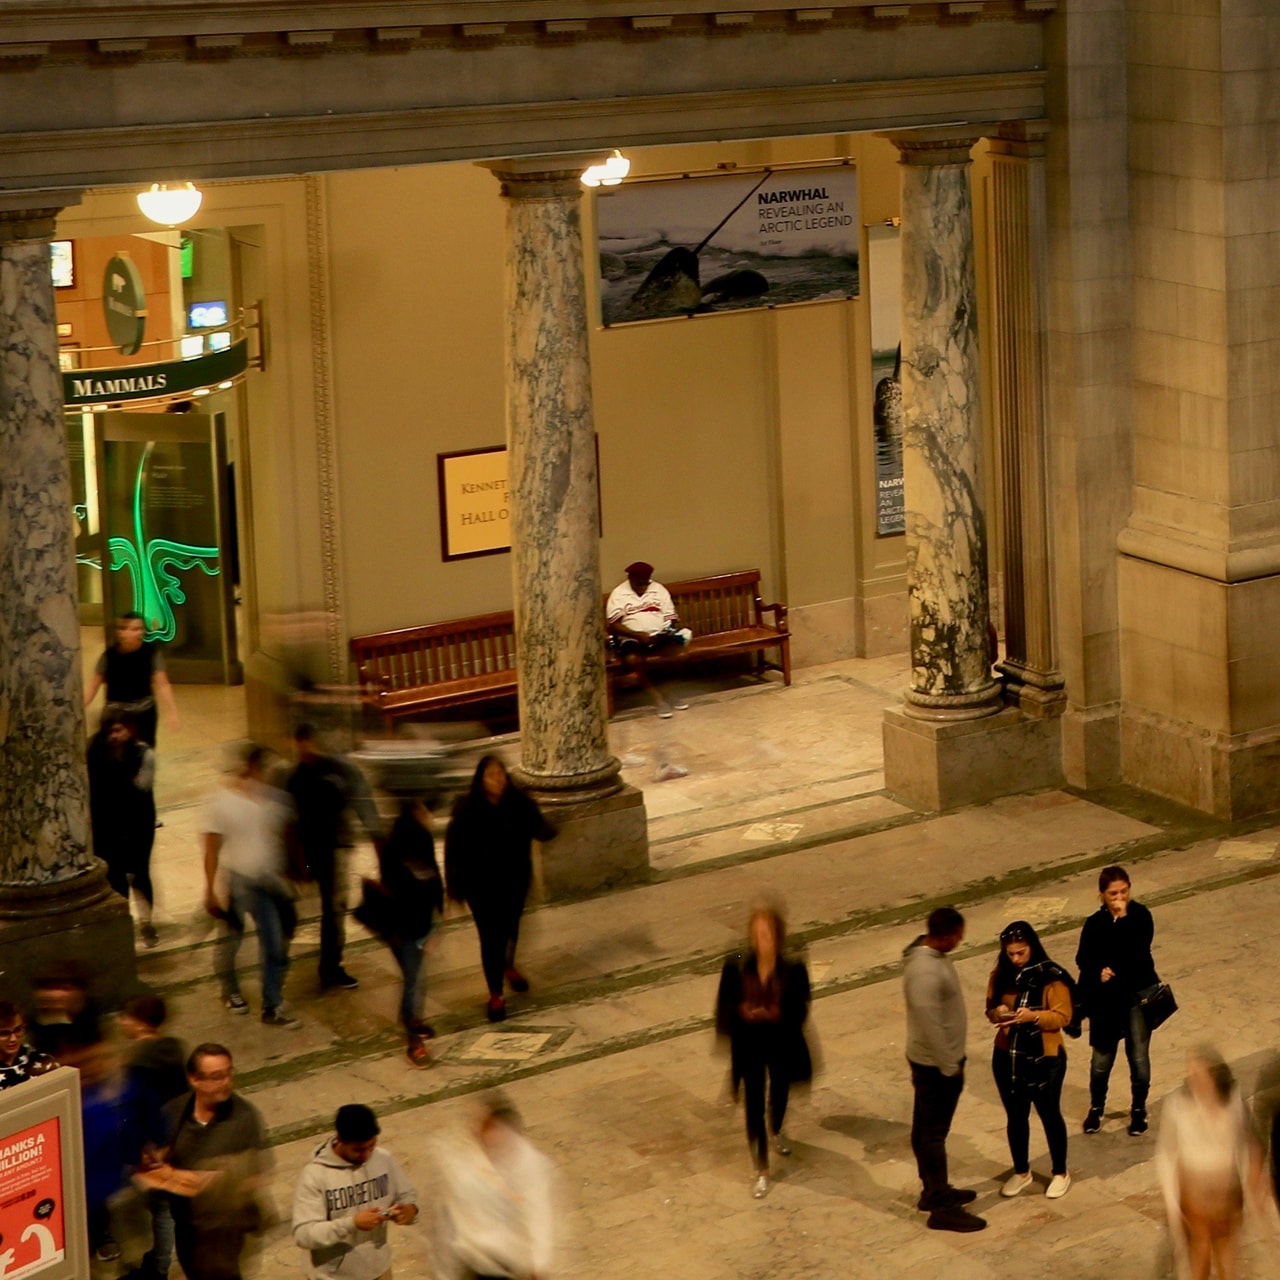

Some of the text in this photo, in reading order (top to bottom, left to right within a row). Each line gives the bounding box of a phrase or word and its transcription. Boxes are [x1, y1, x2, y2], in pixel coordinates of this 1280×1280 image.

[758, 187, 829, 205] NARWHAL
[759, 201, 844, 219] REVEALING AN
[759, 215, 853, 234] ARCTIC LEGEND
[72, 372, 168, 398] MAMMALS
[461, 479, 507, 495] KENNET
[461, 511, 496, 526] HALL
[36, 1133, 46, 1145] A
[0, 1145, 43, 1171] ILLION!
